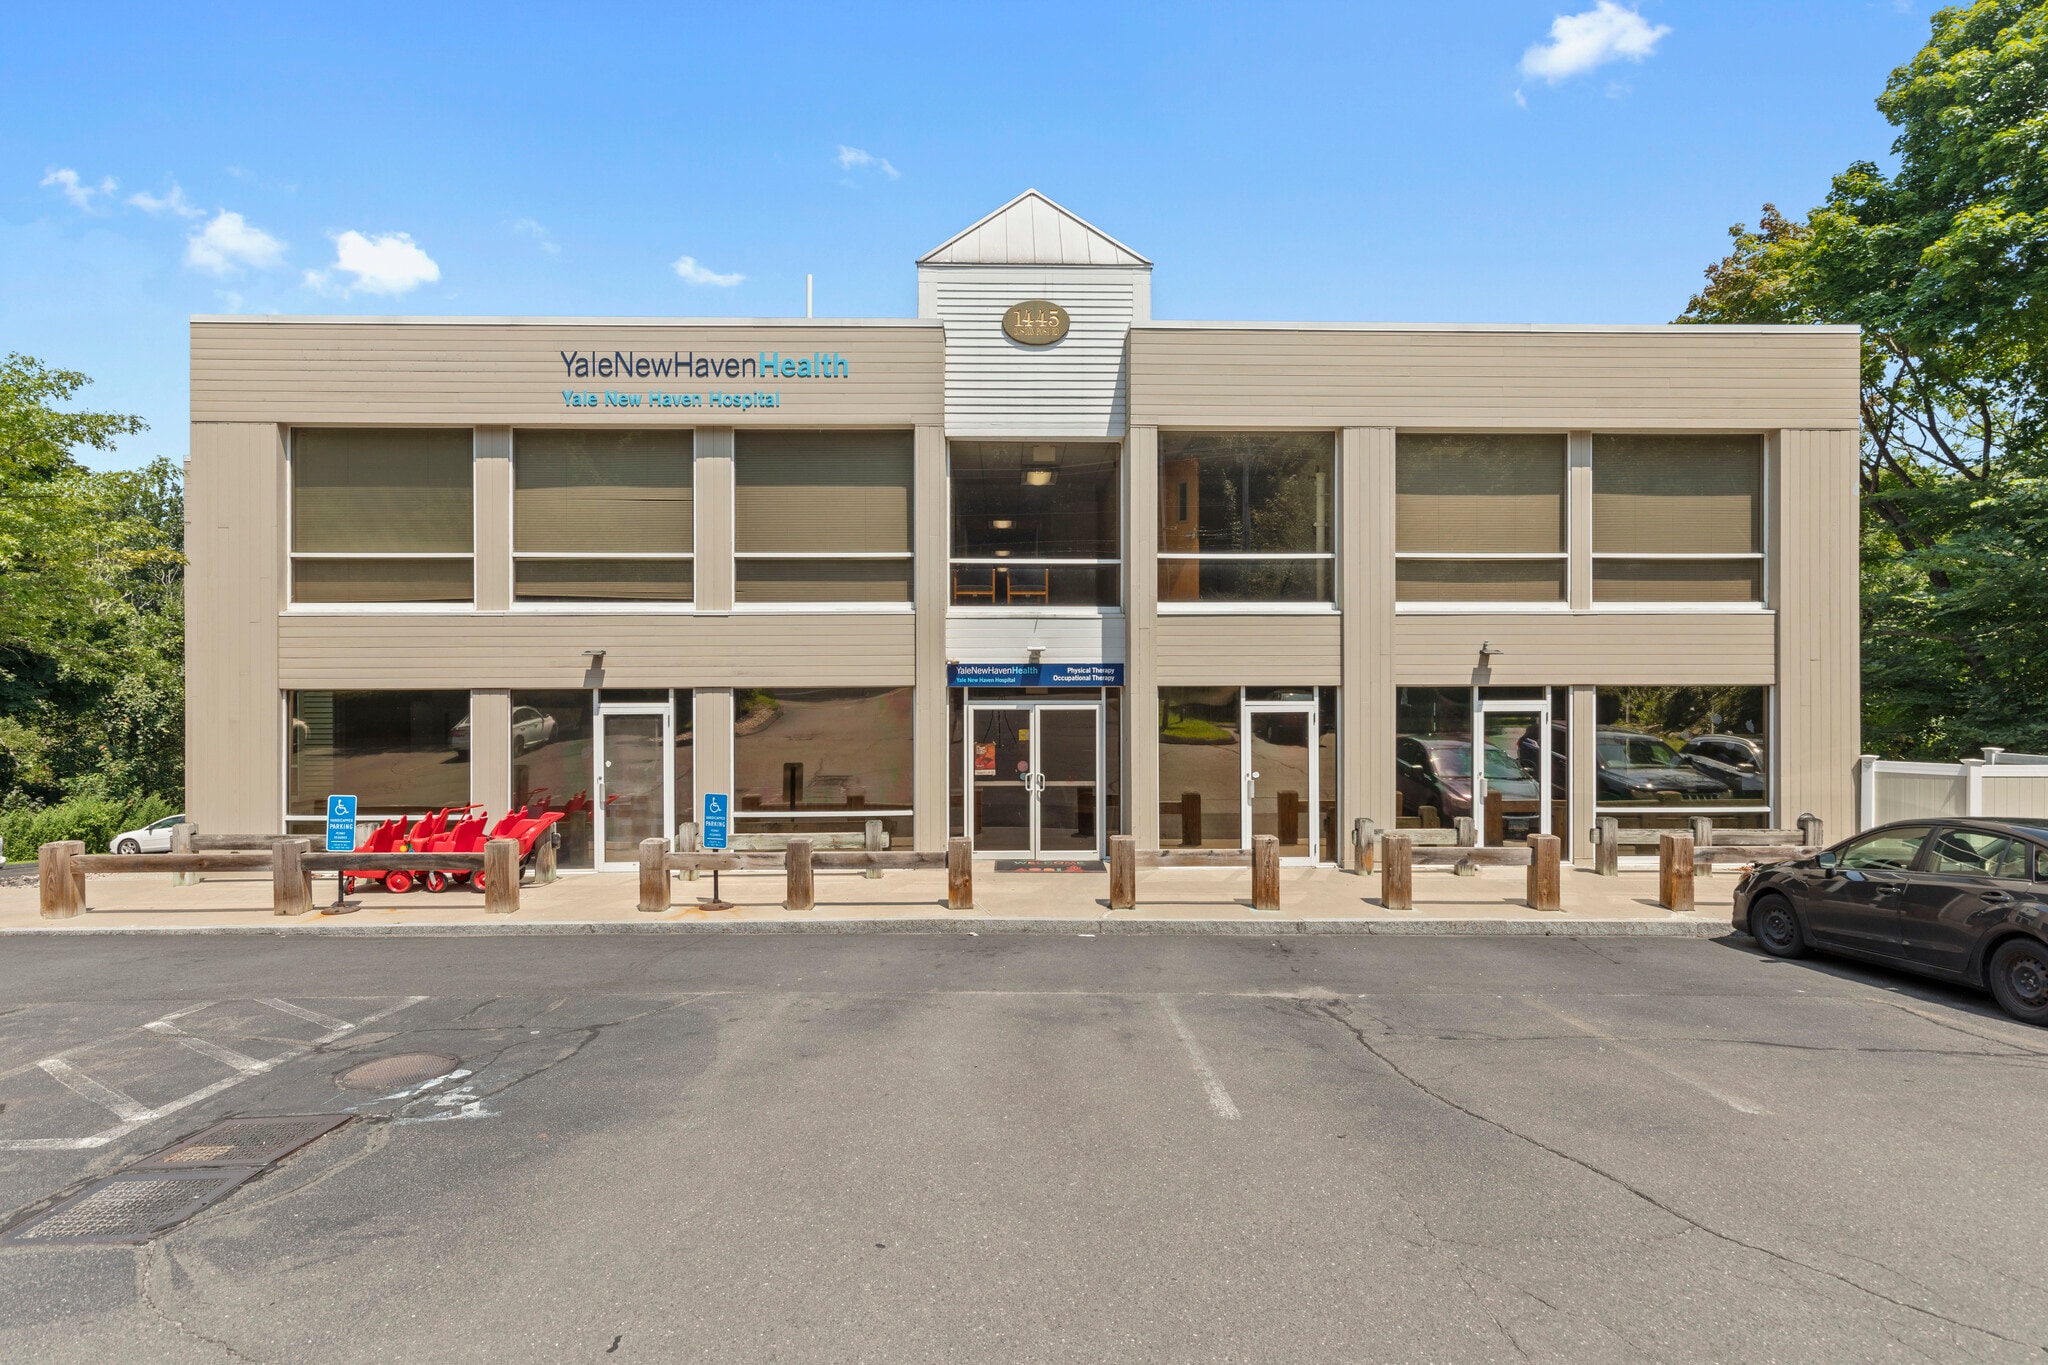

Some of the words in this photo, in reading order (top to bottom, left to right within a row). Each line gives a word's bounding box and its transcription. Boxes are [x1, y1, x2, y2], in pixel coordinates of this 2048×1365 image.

[1013, 309, 1060, 327] 1445
[560, 350, 849, 379] YaleNewHavenHealth
[562, 390, 597, 407] Yale
[604, 390, 642, 407] New
[649, 390, 702, 407] Haven
[709, 390, 780, 411] Hospital
[956, 666, 1038, 675] YaleNewHavenHealth
[1067, 667, 1091, 675] Physical
[1092, 667, 1115, 675] Therapy
[1052, 674, 1091, 682] Occupational
[1092, 674, 1115, 682] Therapy
[705, 820, 726, 828] PARKING
